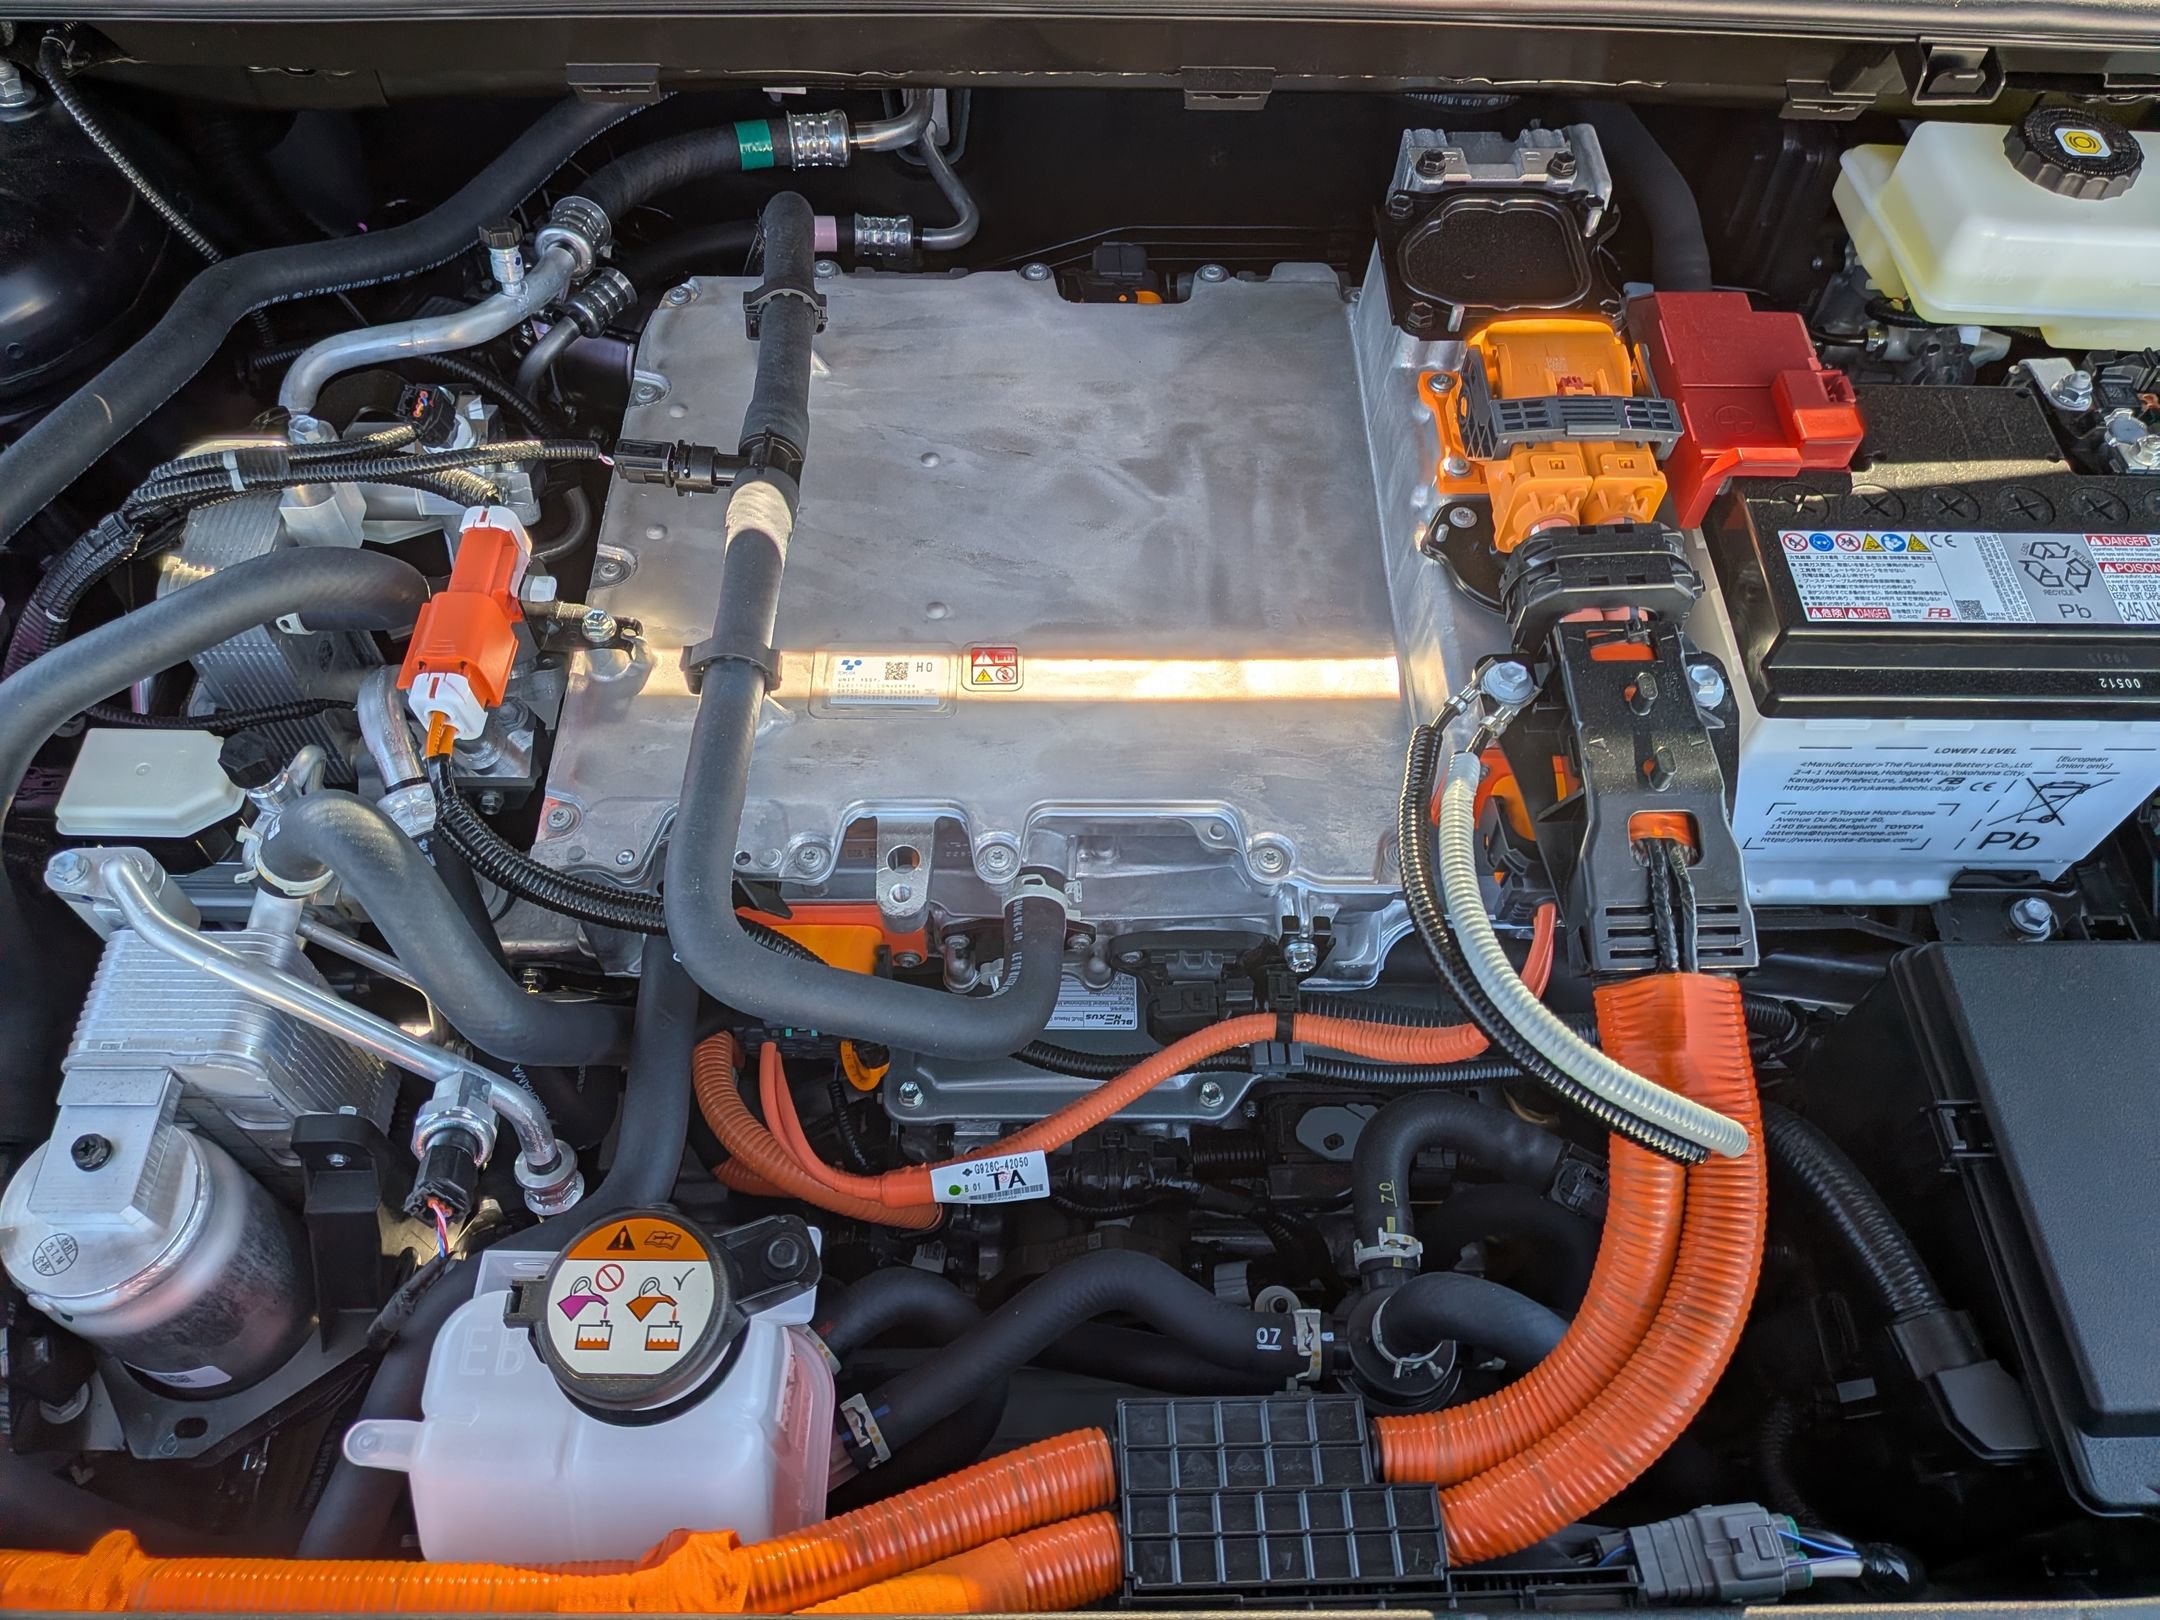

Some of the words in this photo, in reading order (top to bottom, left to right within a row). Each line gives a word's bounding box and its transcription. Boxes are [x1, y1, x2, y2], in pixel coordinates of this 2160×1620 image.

[2101, 536, 2149, 546] DANGER
[1857, 608, 1890, 619] DANGER
[2057, 603, 2092, 619] Pb
[1979, 747, 2017, 755] LEVEL
[1976, 831, 2041, 850] Pb
[1104, 1017, 1133, 1026] BLUE
[987, 1169, 1027, 1191] TA
[1256, 1327, 1282, 1344] 07
